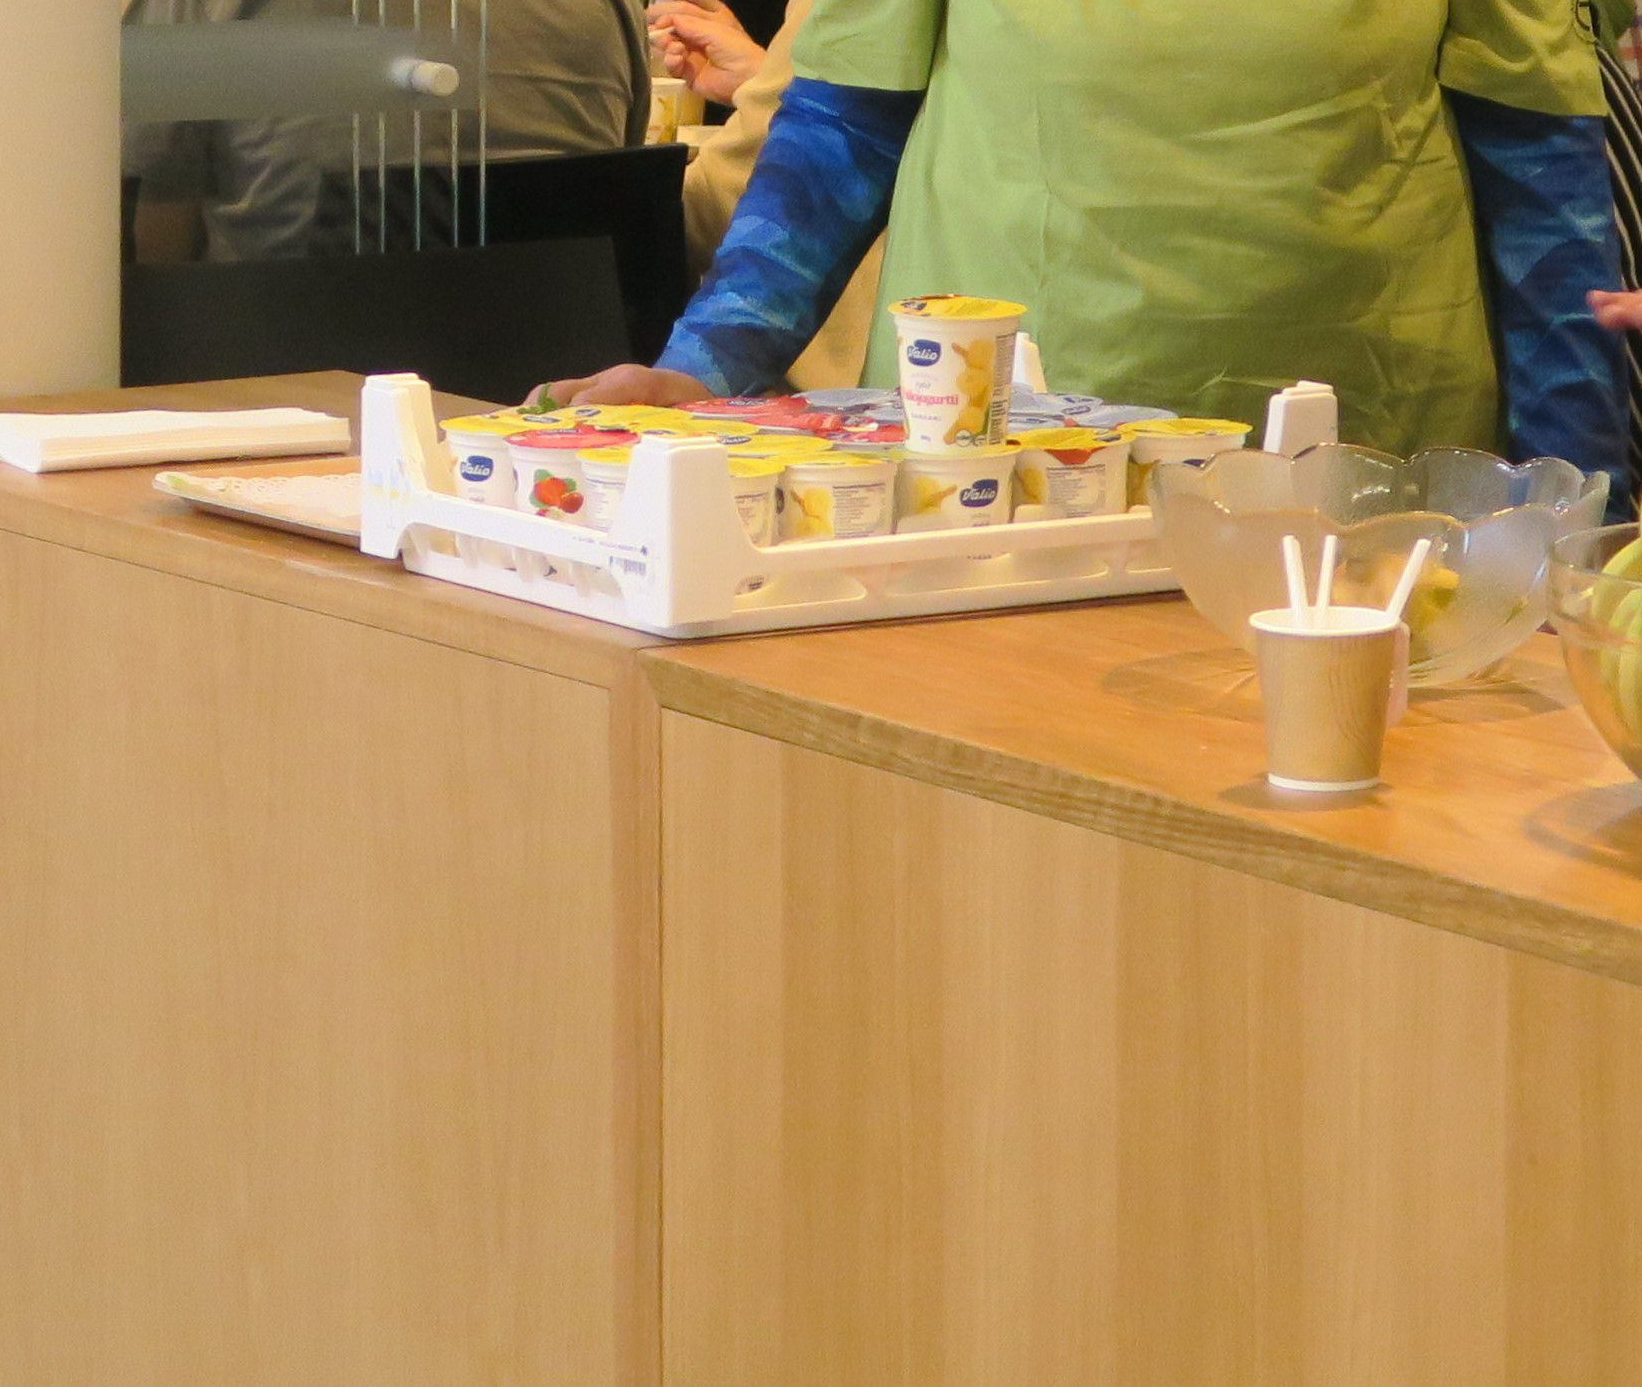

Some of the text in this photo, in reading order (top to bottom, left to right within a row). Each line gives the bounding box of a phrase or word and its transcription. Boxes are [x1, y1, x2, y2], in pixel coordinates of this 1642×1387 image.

[907, 345, 939, 362] Valio
[460, 462, 491, 477] Valio
[961, 487, 997, 502] Valio
